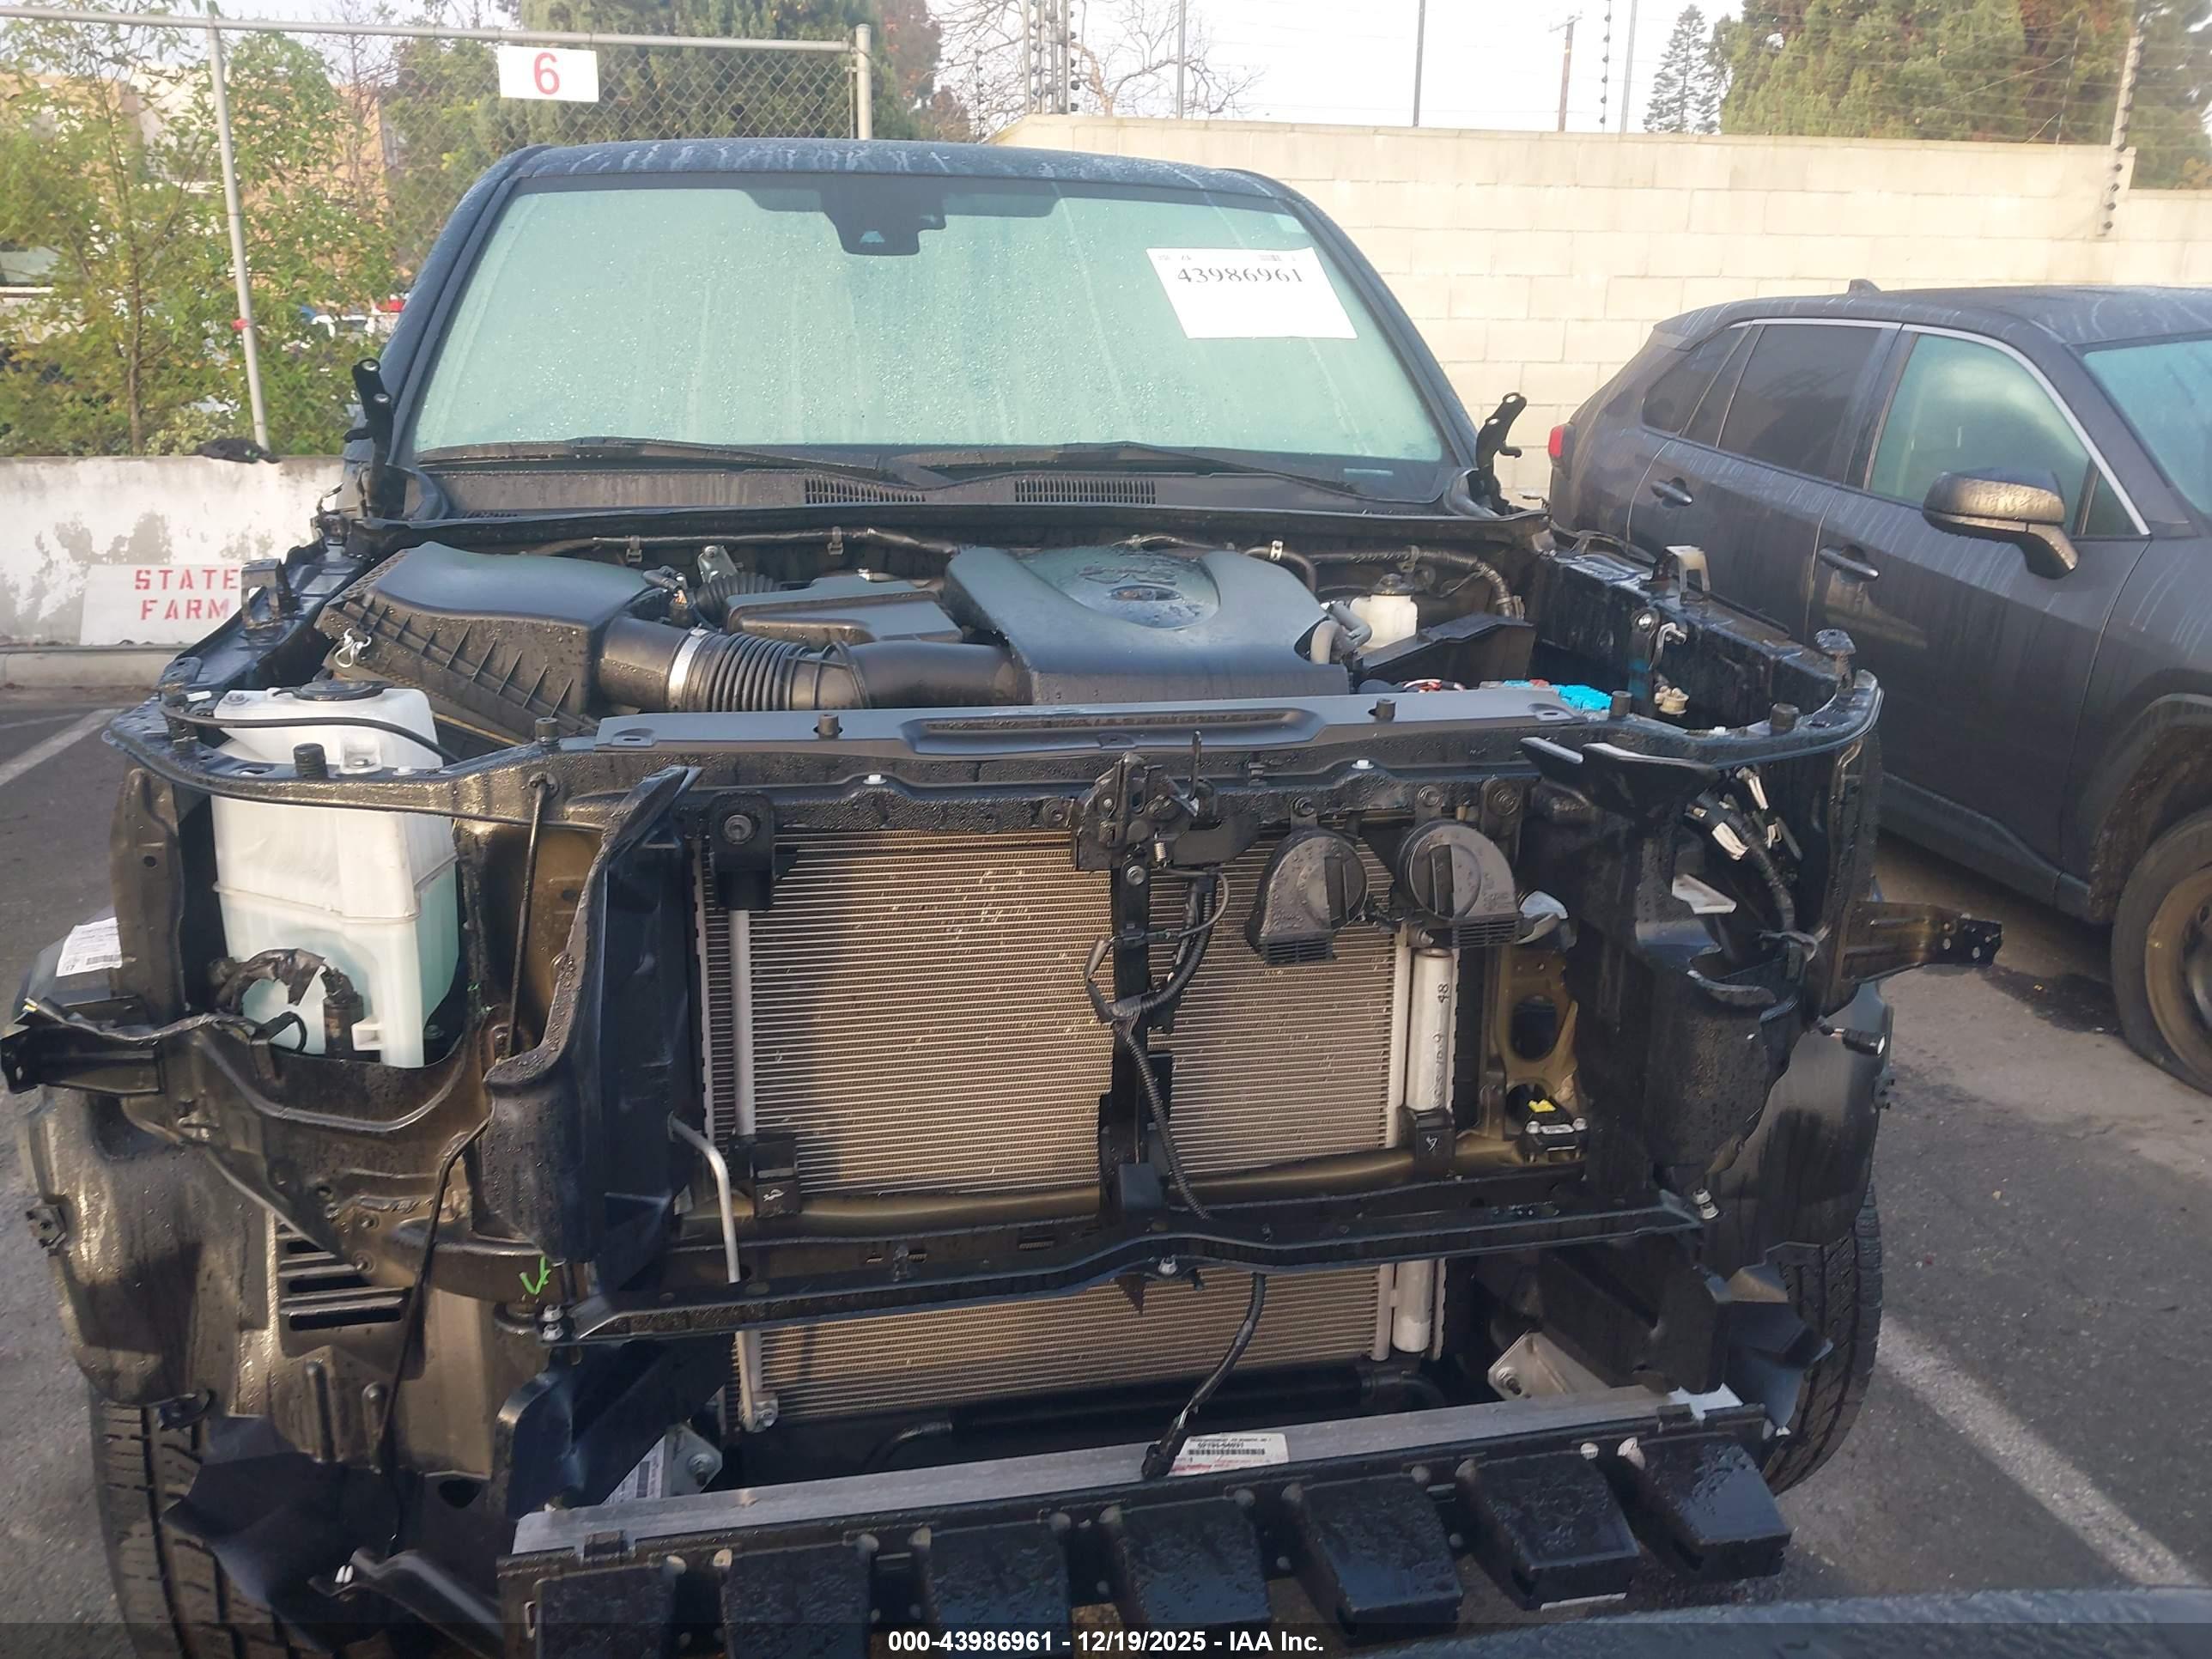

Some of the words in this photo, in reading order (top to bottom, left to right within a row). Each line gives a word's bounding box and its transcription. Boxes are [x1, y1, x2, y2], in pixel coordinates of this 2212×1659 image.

[534, 52, 560, 94] 6
[1177, 267, 1304, 283] 43986961
[135, 569, 239, 590] STATE
[141, 599, 230, 620] FARM
